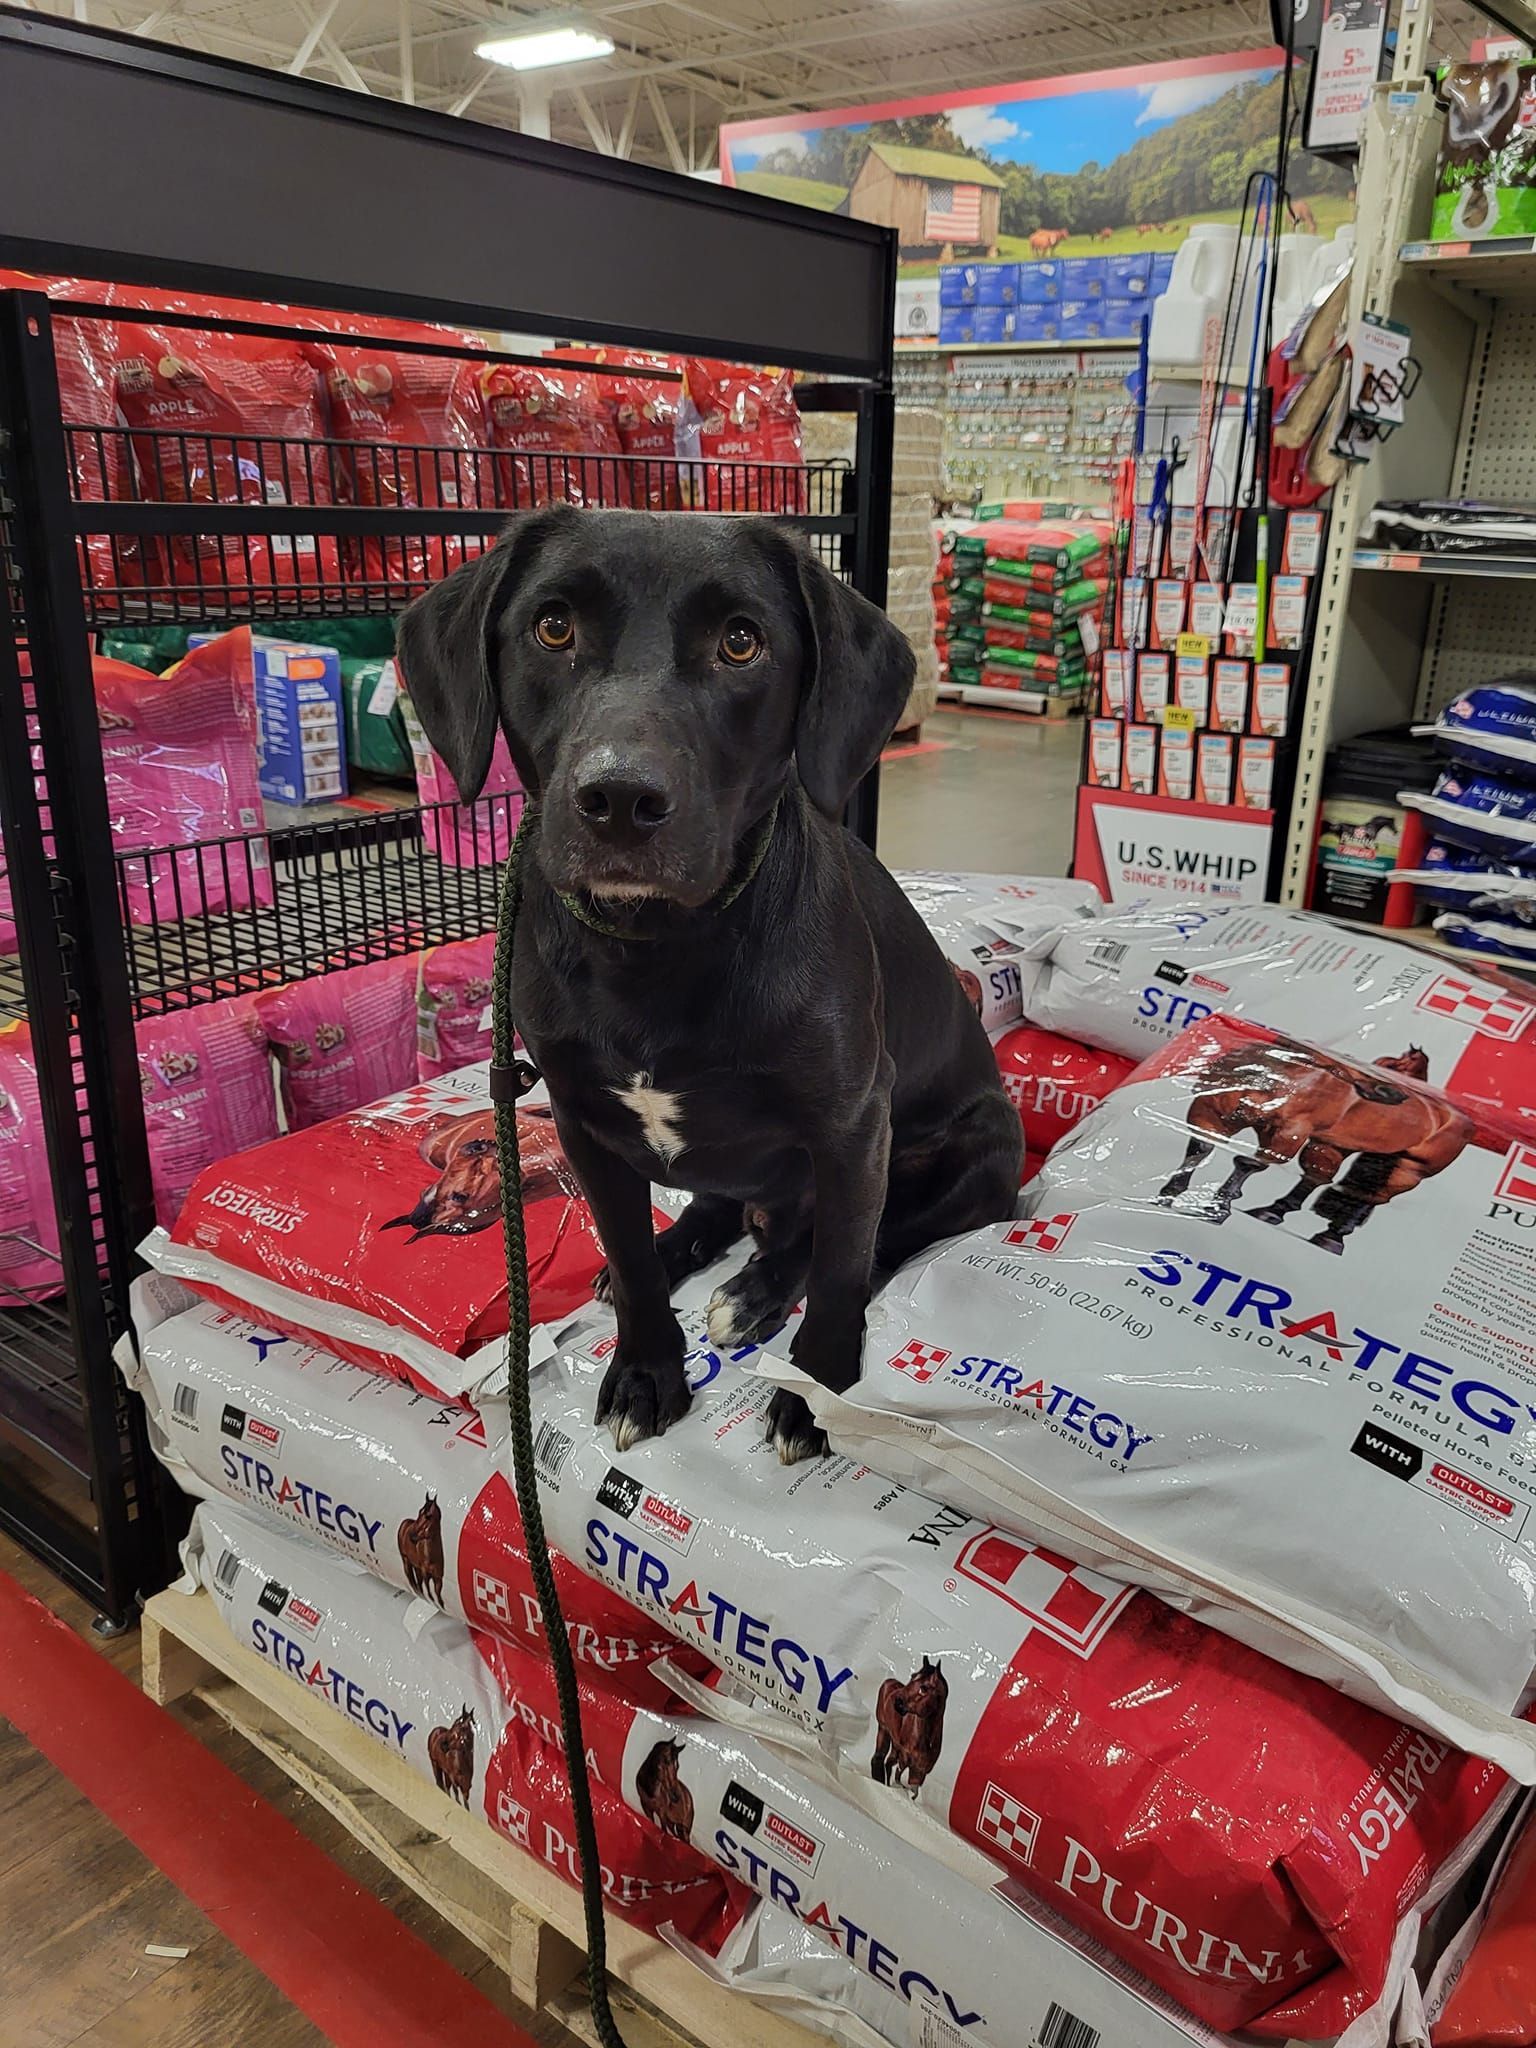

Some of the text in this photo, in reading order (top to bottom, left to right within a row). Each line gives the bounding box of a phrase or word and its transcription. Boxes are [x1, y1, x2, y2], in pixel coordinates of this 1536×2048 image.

[1316, 103, 1366, 117] FINANCIN
[149, 399, 194, 415] APPLE
[518, 431, 551, 445] APPLE
[632, 435, 665, 449] APPLE
[717, 442, 751, 455] APPLE
[1182, 639, 1203, 649] NEW
[1168, 711, 1189, 722] NEW
[1122, 869, 1167, 889] SINCE
[1173, 877, 1207, 893] 1914
[202, 1186, 303, 1235] STRATEGY
[962, 1253, 996, 1271] NET
[994, 1260, 1027, 1282] WT.
[1068, 1289, 1126, 1323] (22.67
[1121, 1313, 1154, 1341] kg)
[1441, 1286, 1479, 1310] proven
[1480, 1306, 1496, 1319] by
[1496, 1311, 1526, 1332] years
[1446, 1279, 1488, 1304] support
[1423, 1321, 1536, 1377] supplement to suppo
[1428, 1313, 1518, 1358] Formulated with
[1433, 1302, 1535, 1355] Gastric Support
[1124, 1277, 1331, 1373] PROFESSIONAL
[1348, 1372, 1491, 1449] FORMULA
[1419, 1328, 1536, 1388] gastric health & prope
[223, 1415, 242, 1431] WITH
[249, 1420, 278, 1441] OUTLAST
[713, 1391, 771, 1440] with OUTLAST
[943, 1375, 1129, 1474] PROFESSIONAL FORMULA GX
[951, 1356, 1154, 1461] STRATEGY
[1364, 1433, 1413, 1467] WITH
[1372, 1403, 1441, 1443] Pelleted
[1444, 1438, 1494, 1472] Horse
[220, 1444, 383, 1554] STRATEGY
[872, 1488, 899, 1513] Ages
[1425, 1477, 1508, 1523] GASTRIC SUPPOR
[1437, 1467, 1510, 1512] OUTLAST
[647, 1499, 688, 1530] OUTLAST
[907, 1504, 973, 1548] INA
[264, 1587, 284, 1606] WITH
[291, 1599, 319, 1623] OUTLAST
[585, 1518, 853, 1714] STRATEGY
[587, 1560, 706, 1649] PROFESSIONAL
[713, 1646, 800, 1704] FORMULA
[251, 1618, 414, 1749] STRATEGY
[727, 1794, 758, 1823] WITH
[1348, 1733, 1450, 1878] TRATEGY
[1349, 1762, 1386, 1813] FORMULA
[769, 1817, 814, 1852] OUTLAST
[1336, 1814, 1351, 1832] GX
[786, 1842, 812, 1868] SUPPORT
